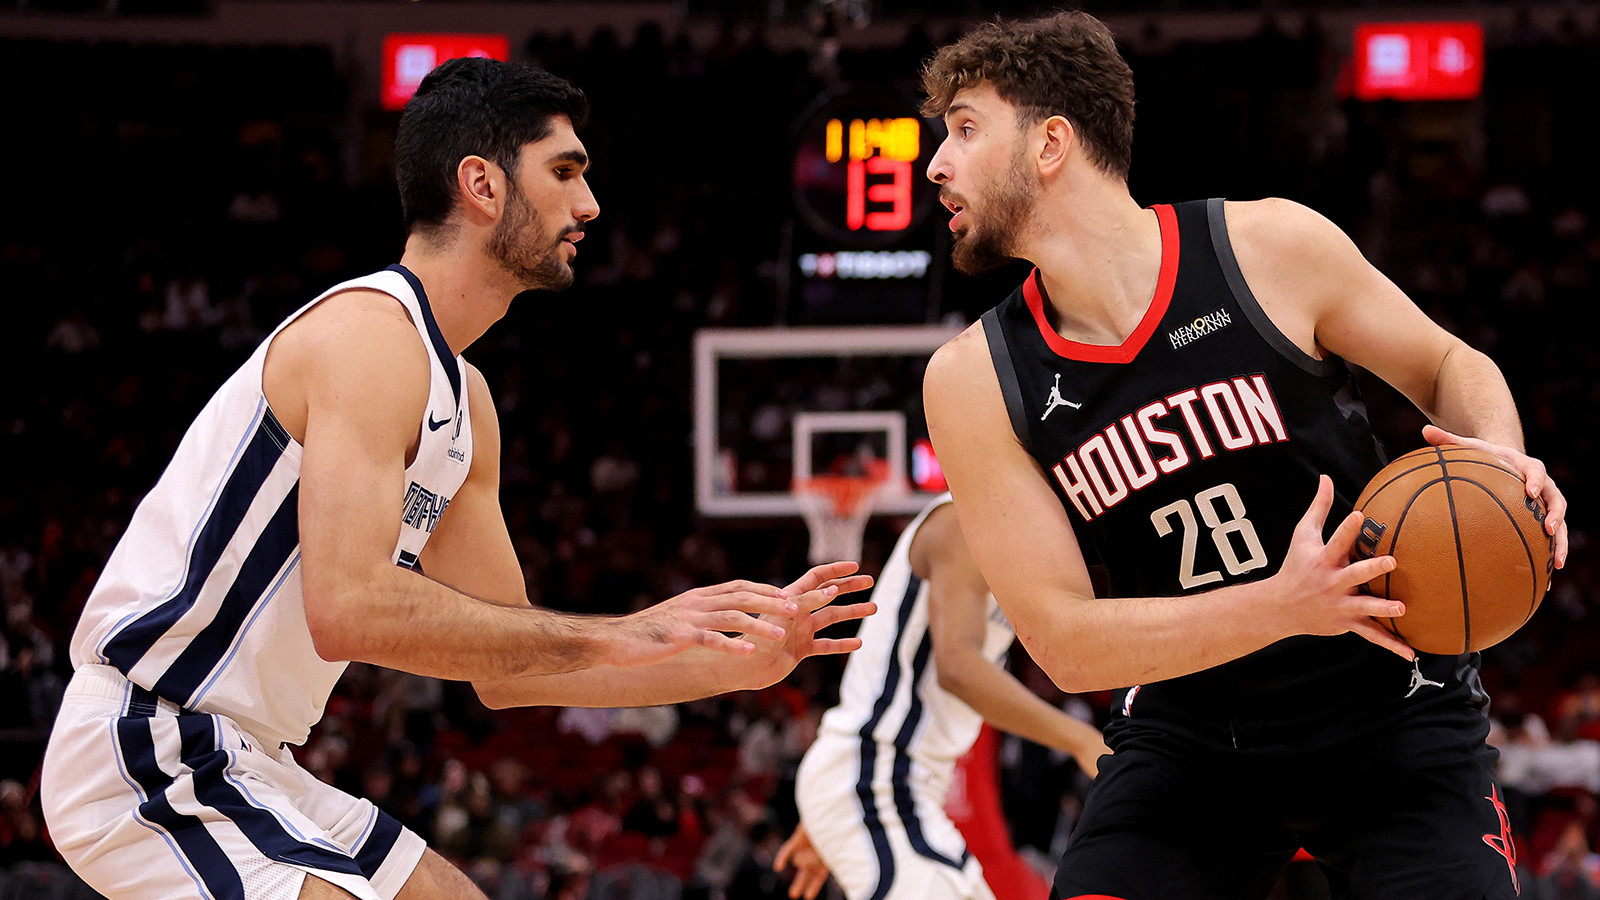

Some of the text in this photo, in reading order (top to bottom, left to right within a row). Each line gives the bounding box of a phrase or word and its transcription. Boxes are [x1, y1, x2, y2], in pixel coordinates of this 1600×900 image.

[847, 158, 912, 231] 13
[1168, 308, 1229, 341] MEMORIAL
[1170, 313, 1232, 349] HERMANN
[1051, 373, 1290, 522] HOUSTON
[1150, 483, 1268, 590] 28
